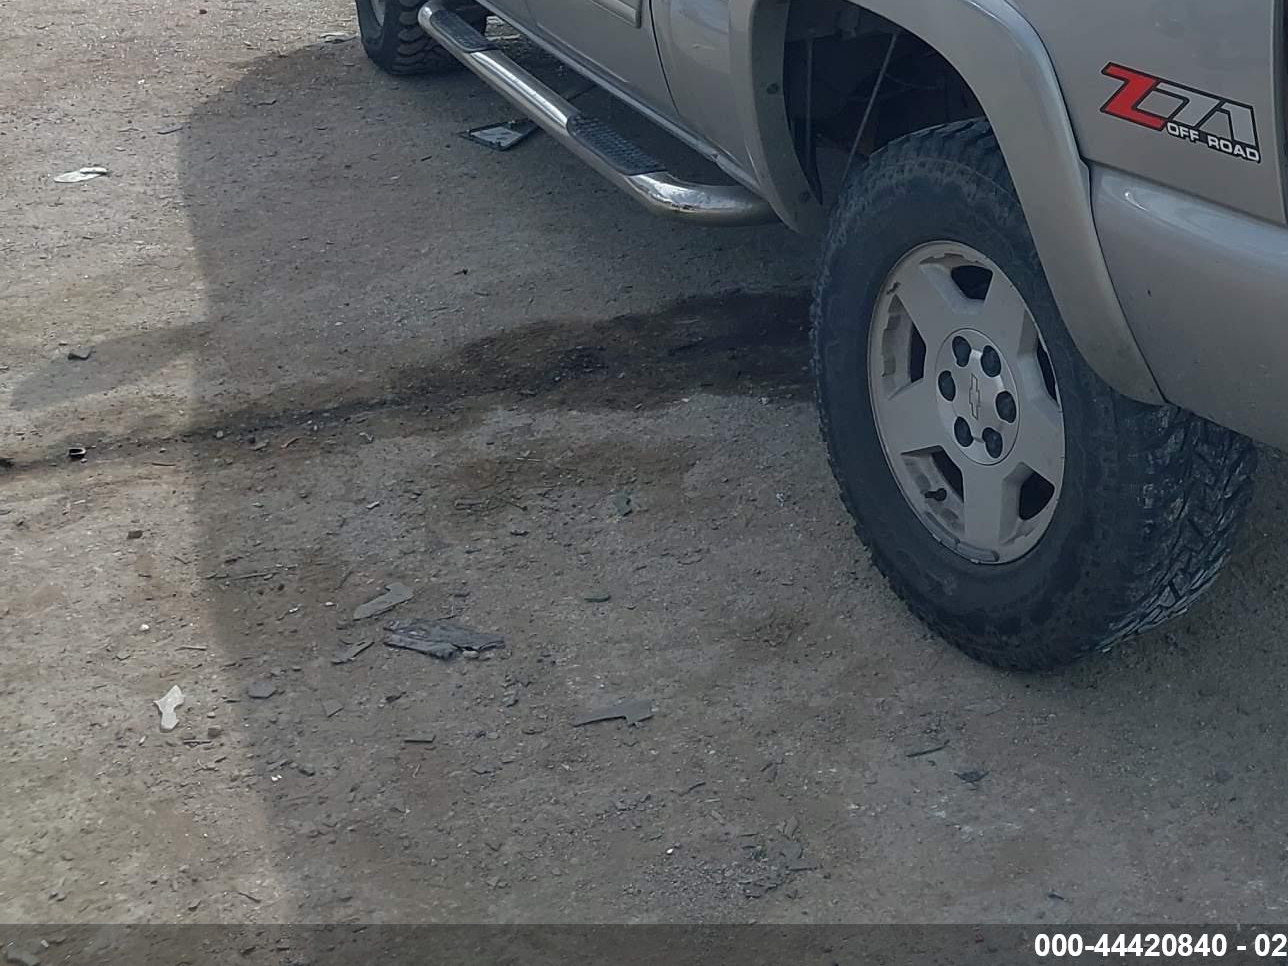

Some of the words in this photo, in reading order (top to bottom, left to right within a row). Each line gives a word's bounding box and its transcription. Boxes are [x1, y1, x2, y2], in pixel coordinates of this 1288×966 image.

[1100, 62, 1259, 148] Z71
[1166, 122, 1200, 142] OFF
[1207, 135, 1260, 162] ROAD
